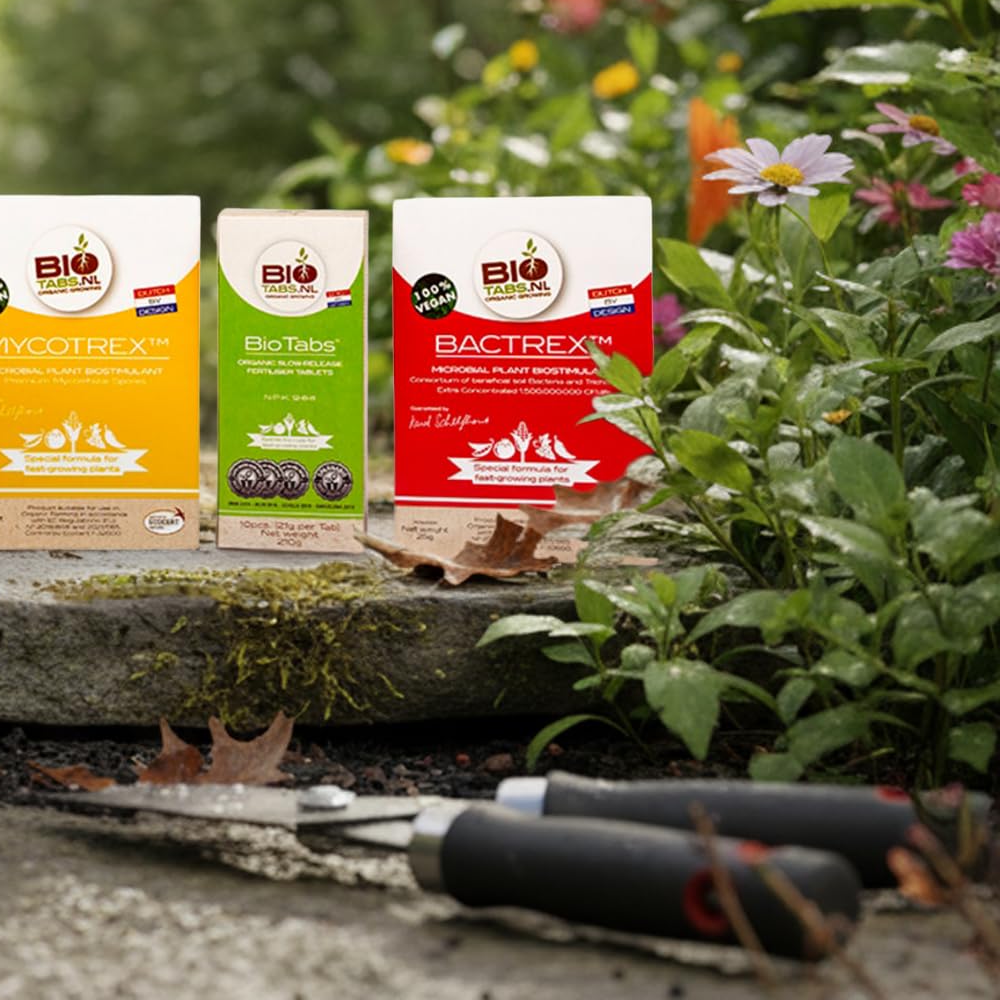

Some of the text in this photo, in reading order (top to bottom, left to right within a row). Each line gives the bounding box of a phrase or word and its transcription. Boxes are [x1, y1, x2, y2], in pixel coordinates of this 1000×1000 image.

[35, 253, 99, 278] BIO
[481, 257, 548, 285] BIO
[262, 264, 317, 284] BIO
[36, 276, 100, 288] TABS.NL
[262, 284, 318, 294] TABS.NL
[414, 279, 451, 301] 100%
[483, 281, 550, 295] TABS.NL
[416, 292, 457, 314] VEGAN
[47, 367, 82, 375] PLANT
[431, 365, 599, 375] MICROBIAL PLANT BIOSTIMULA
[24, 455, 118, 463] Special formula for
[89, 465, 120, 473] plants
[474, 464, 568, 473] Special formula for
[474, 474, 571, 484] fast-growing plants
